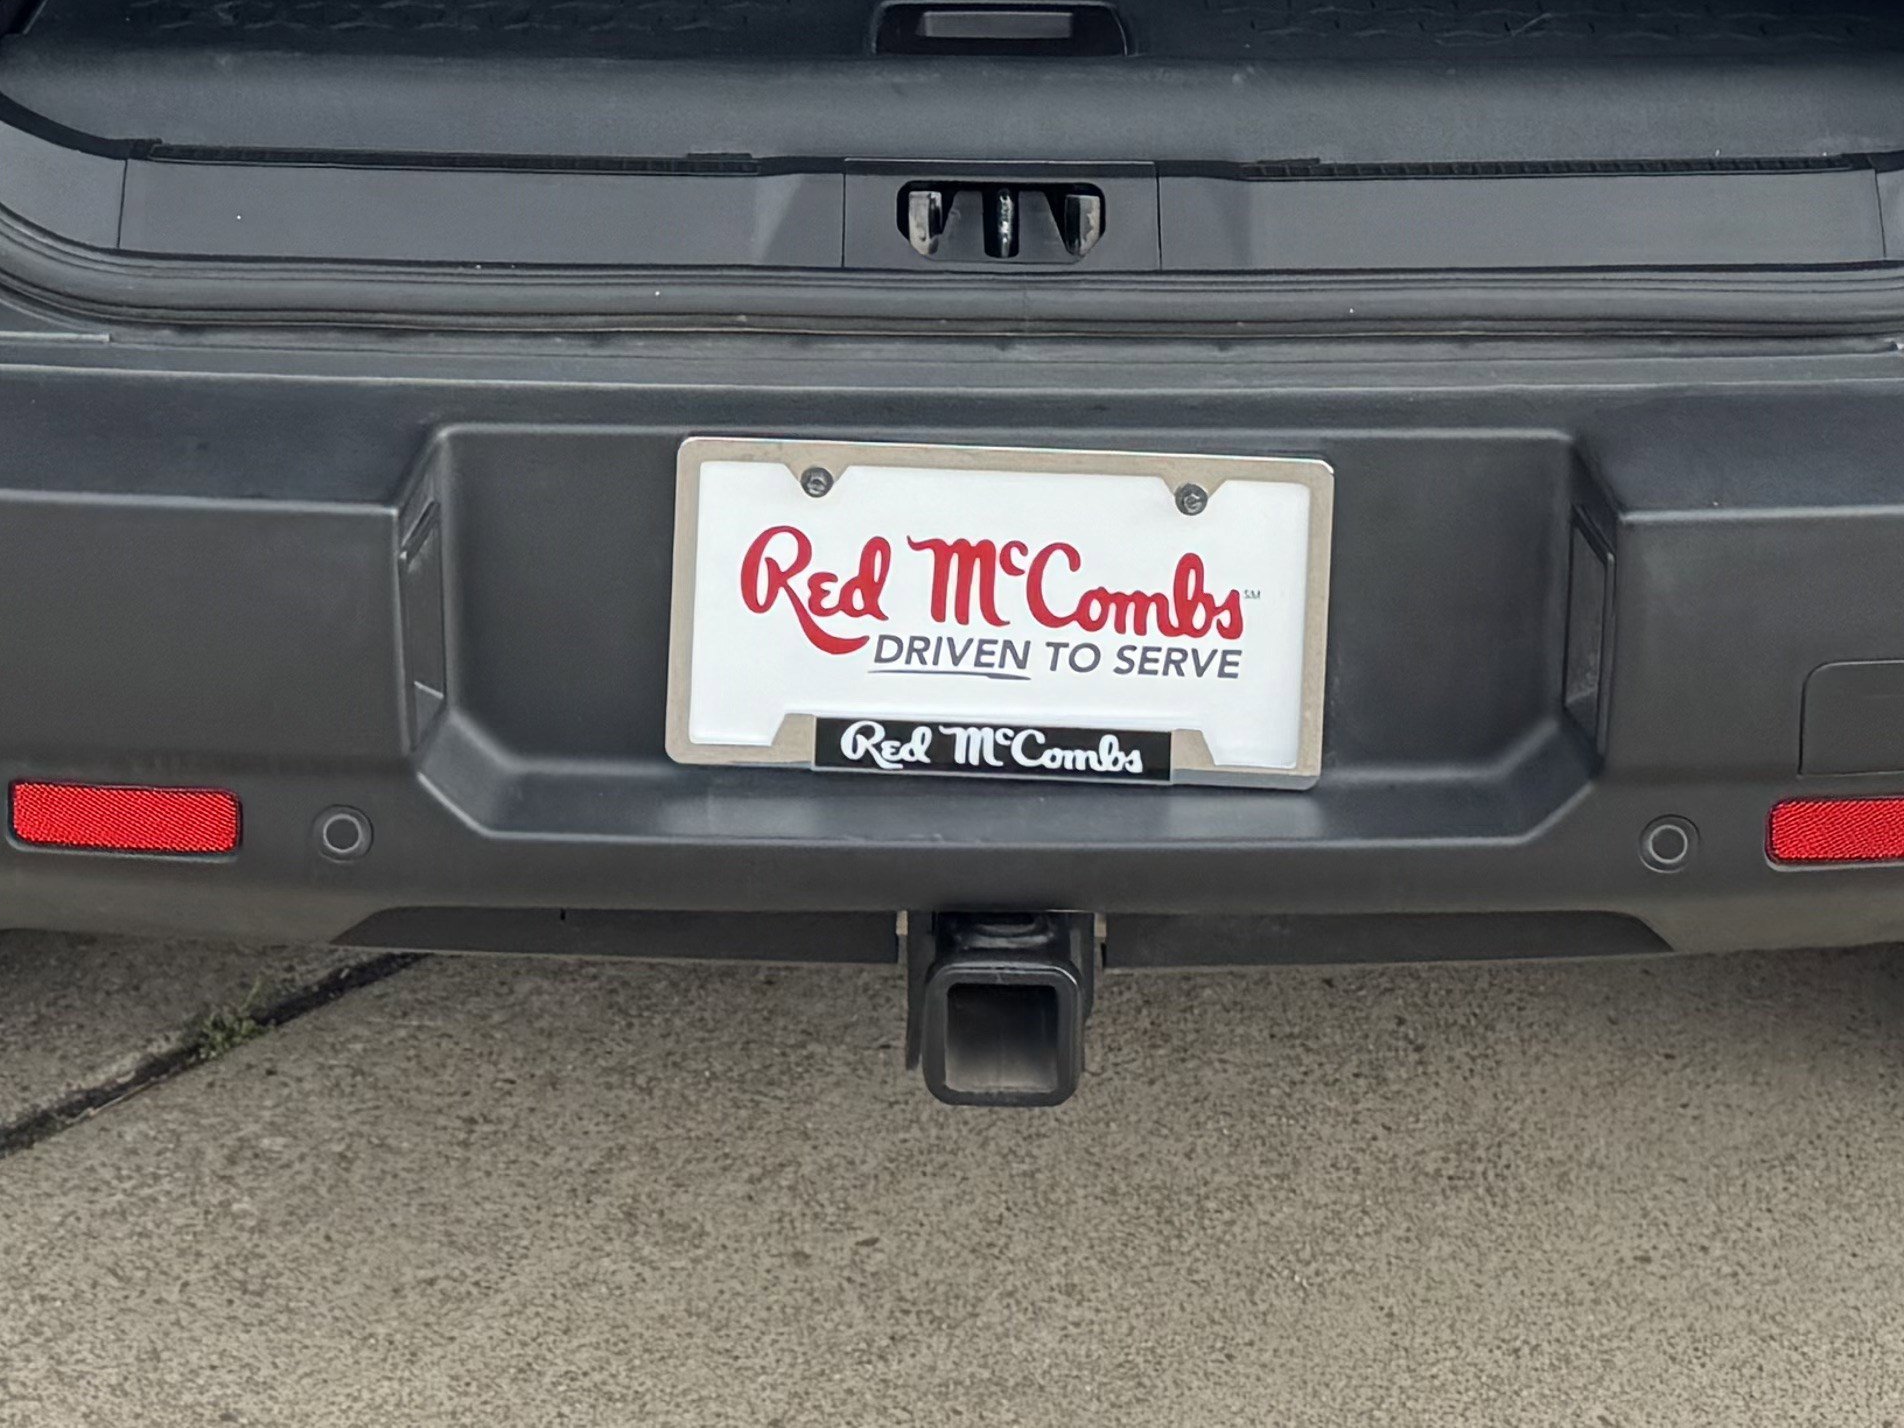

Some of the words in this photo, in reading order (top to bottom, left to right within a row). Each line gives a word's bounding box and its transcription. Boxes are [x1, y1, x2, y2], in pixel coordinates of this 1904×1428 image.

[740, 525, 892, 655] Red
[906, 536, 1244, 641] McCombs
[874, 634, 1031, 670] DRIVEN
[1045, 641, 1101, 673] TO
[1113, 644, 1243, 679] SERVE
[839, 719, 934, 770] Red
[939, 725, 1144, 775] McCombs
